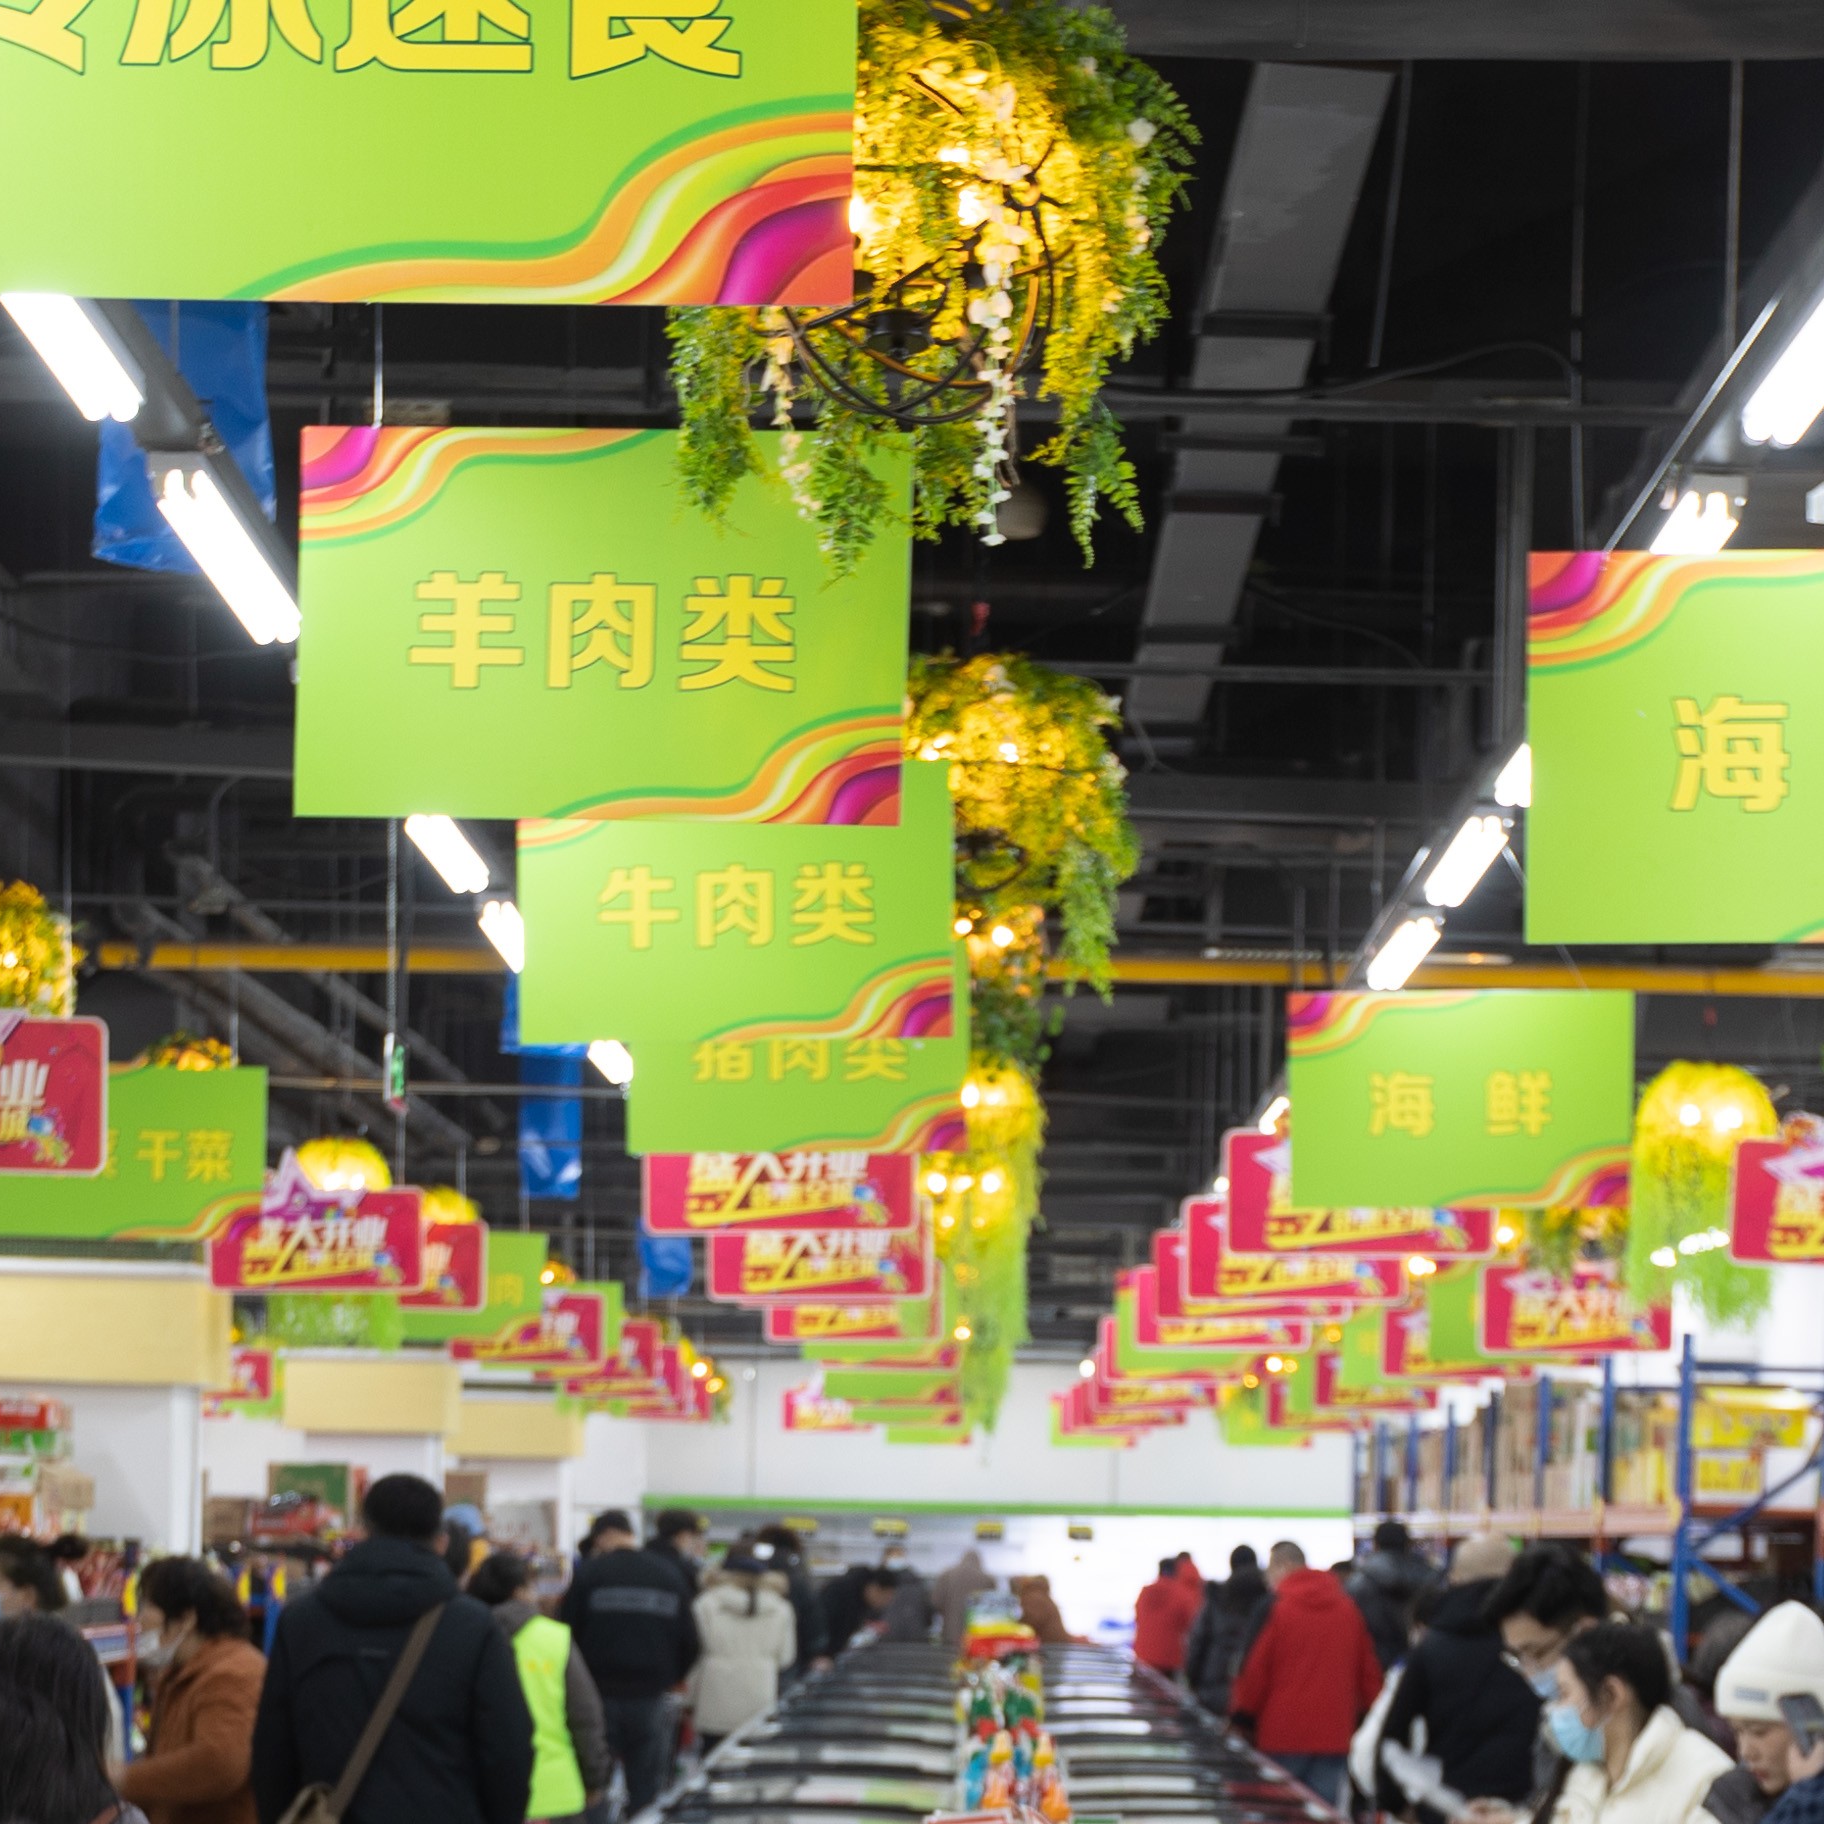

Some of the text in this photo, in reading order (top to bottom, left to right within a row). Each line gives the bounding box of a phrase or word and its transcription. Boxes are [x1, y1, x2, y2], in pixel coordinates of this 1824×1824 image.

[406, 569, 798, 695] 羊肉类
[597, 861, 876, 950] 牛肉类
[1368, 1070, 1553, 1137] 海鲜
